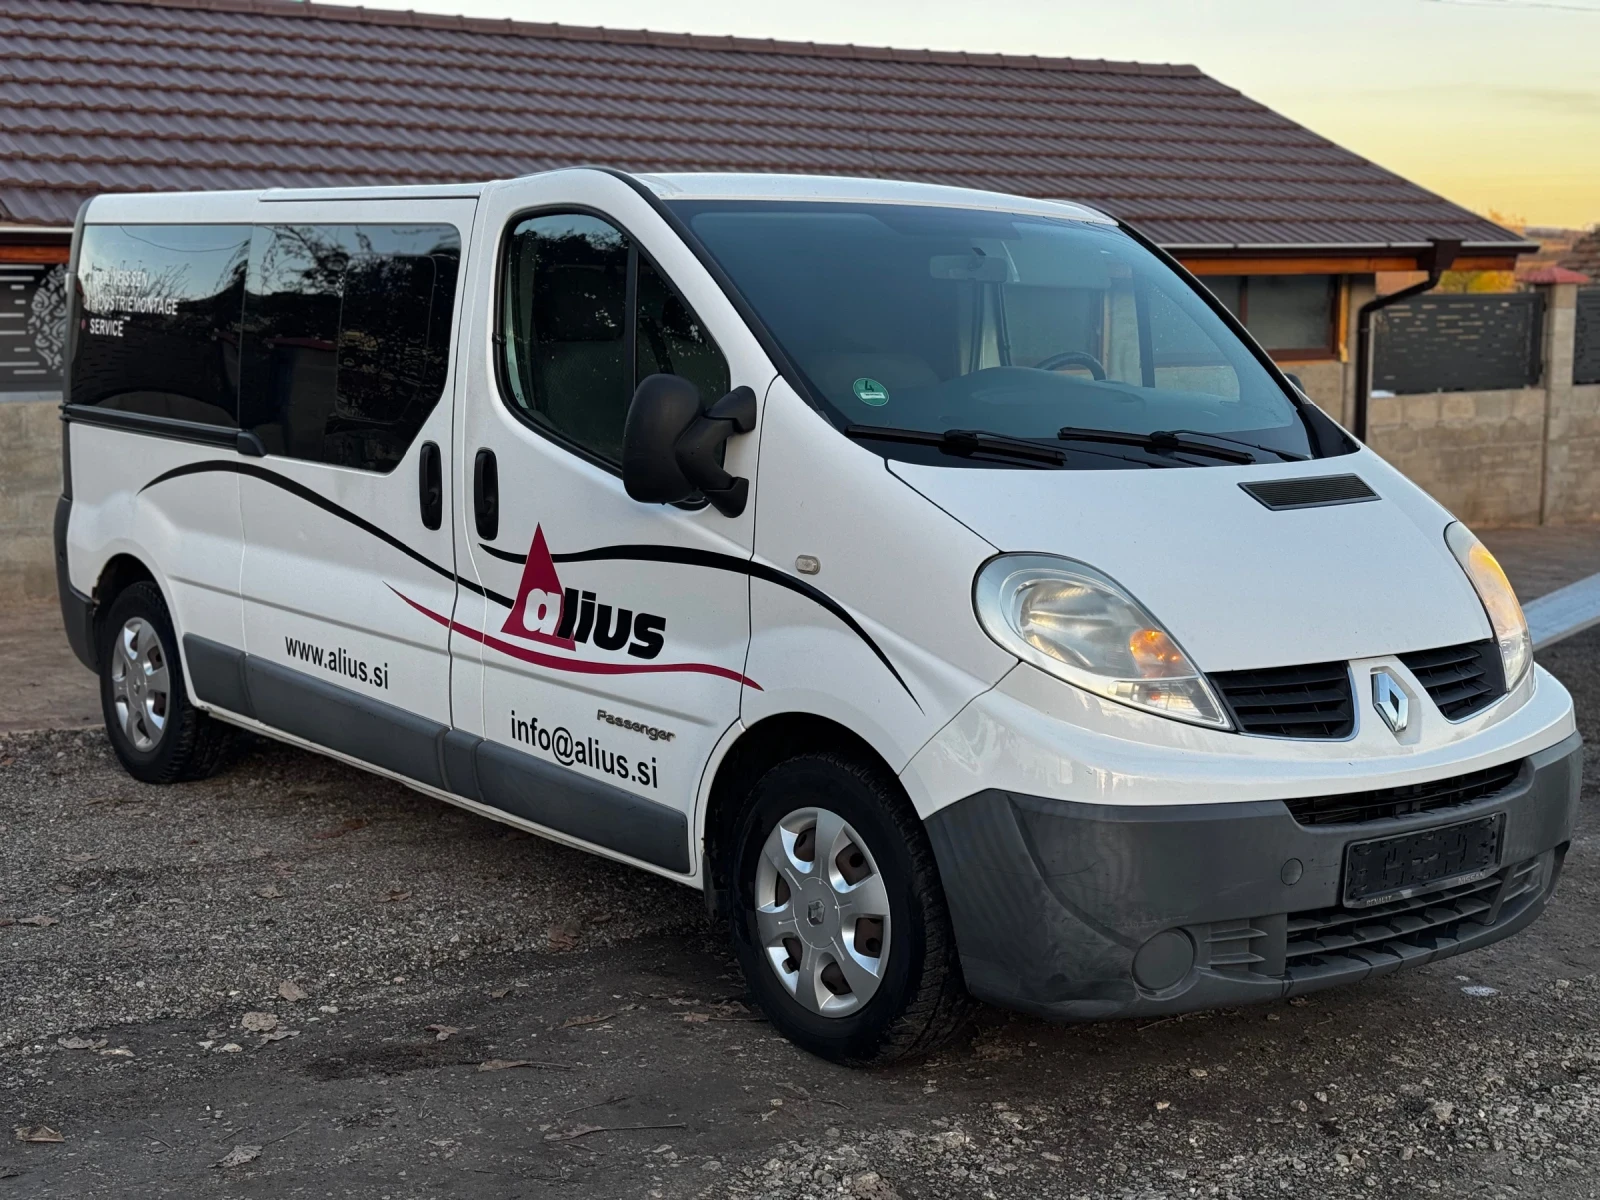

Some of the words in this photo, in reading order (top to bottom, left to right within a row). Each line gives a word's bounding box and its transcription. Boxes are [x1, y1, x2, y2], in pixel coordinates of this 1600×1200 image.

[89, 318, 124, 337] SERVICE
[865, 380, 875, 392] 4
[522, 586, 667, 660] alius
[285, 635, 389, 690] www.alius.si
[596, 709, 676, 742] Passenger
[511, 709, 658, 789] info@alius.si
[1458, 870, 1486, 885] NISSAN
[1366, 895, 1392, 906] RENAULT
